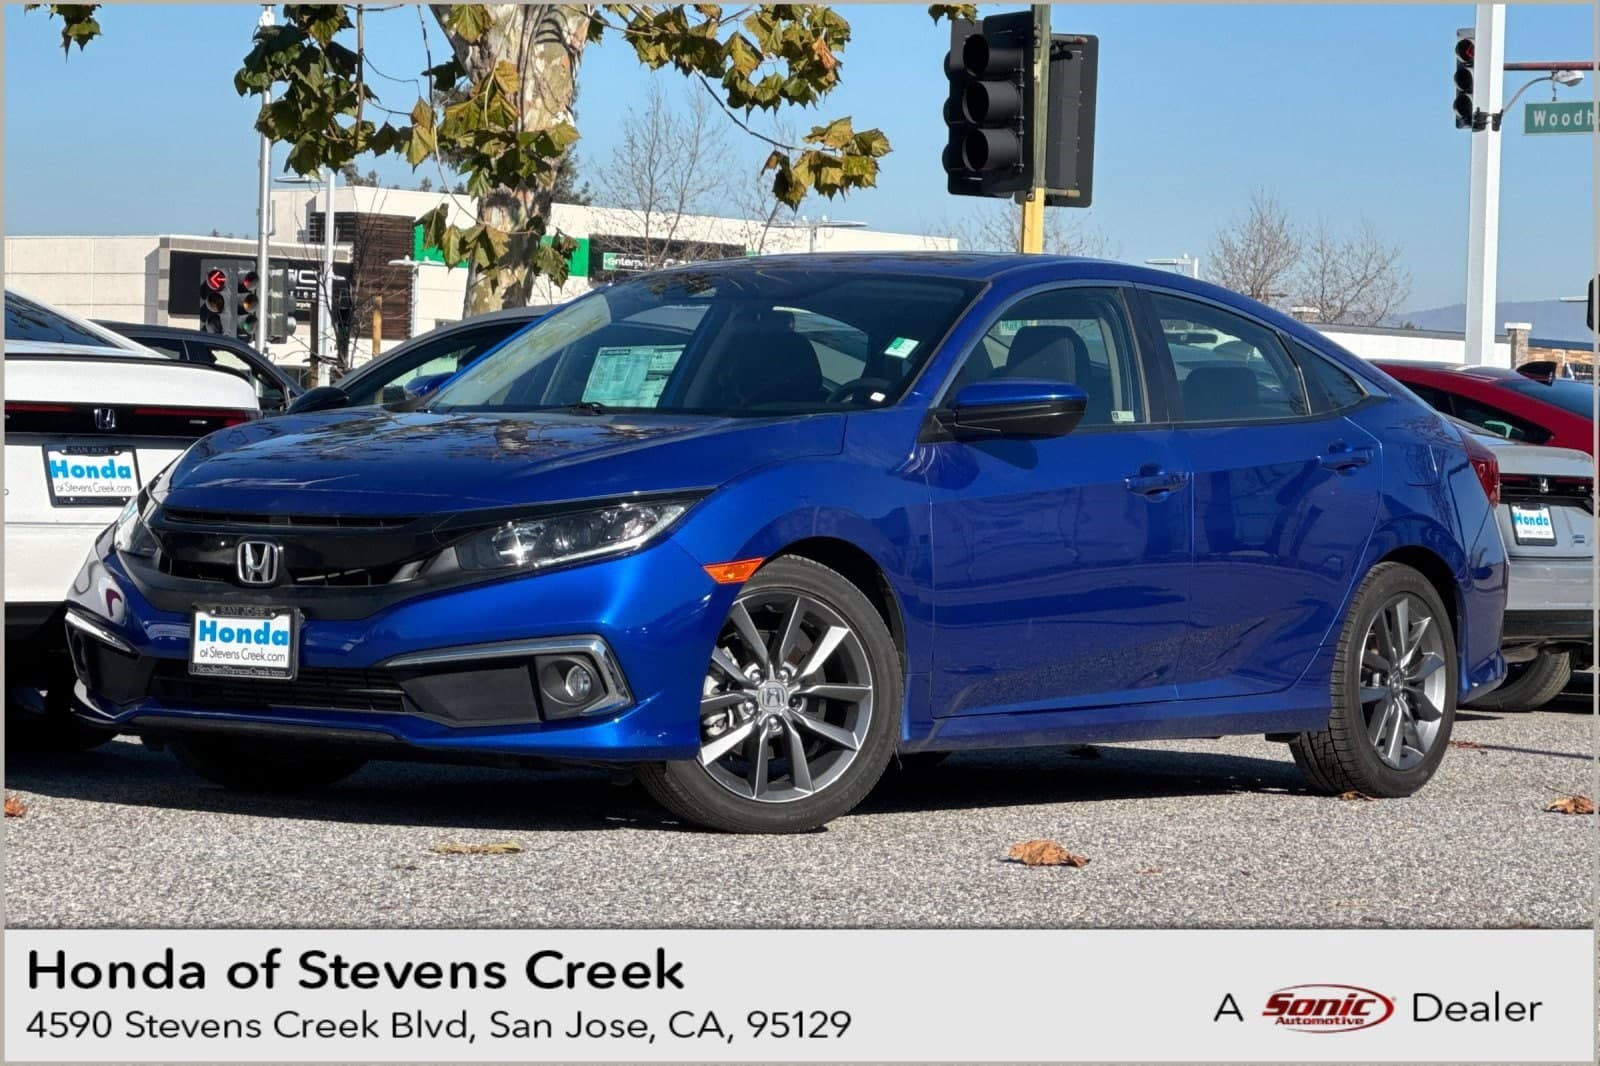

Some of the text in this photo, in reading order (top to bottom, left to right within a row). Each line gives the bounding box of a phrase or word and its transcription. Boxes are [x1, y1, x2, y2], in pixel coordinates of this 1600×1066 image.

[50, 459, 132, 479] Honda
[1512, 512, 1549, 526] Honda
[199, 620, 289, 646] Honda
[200, 649, 208, 658] of
